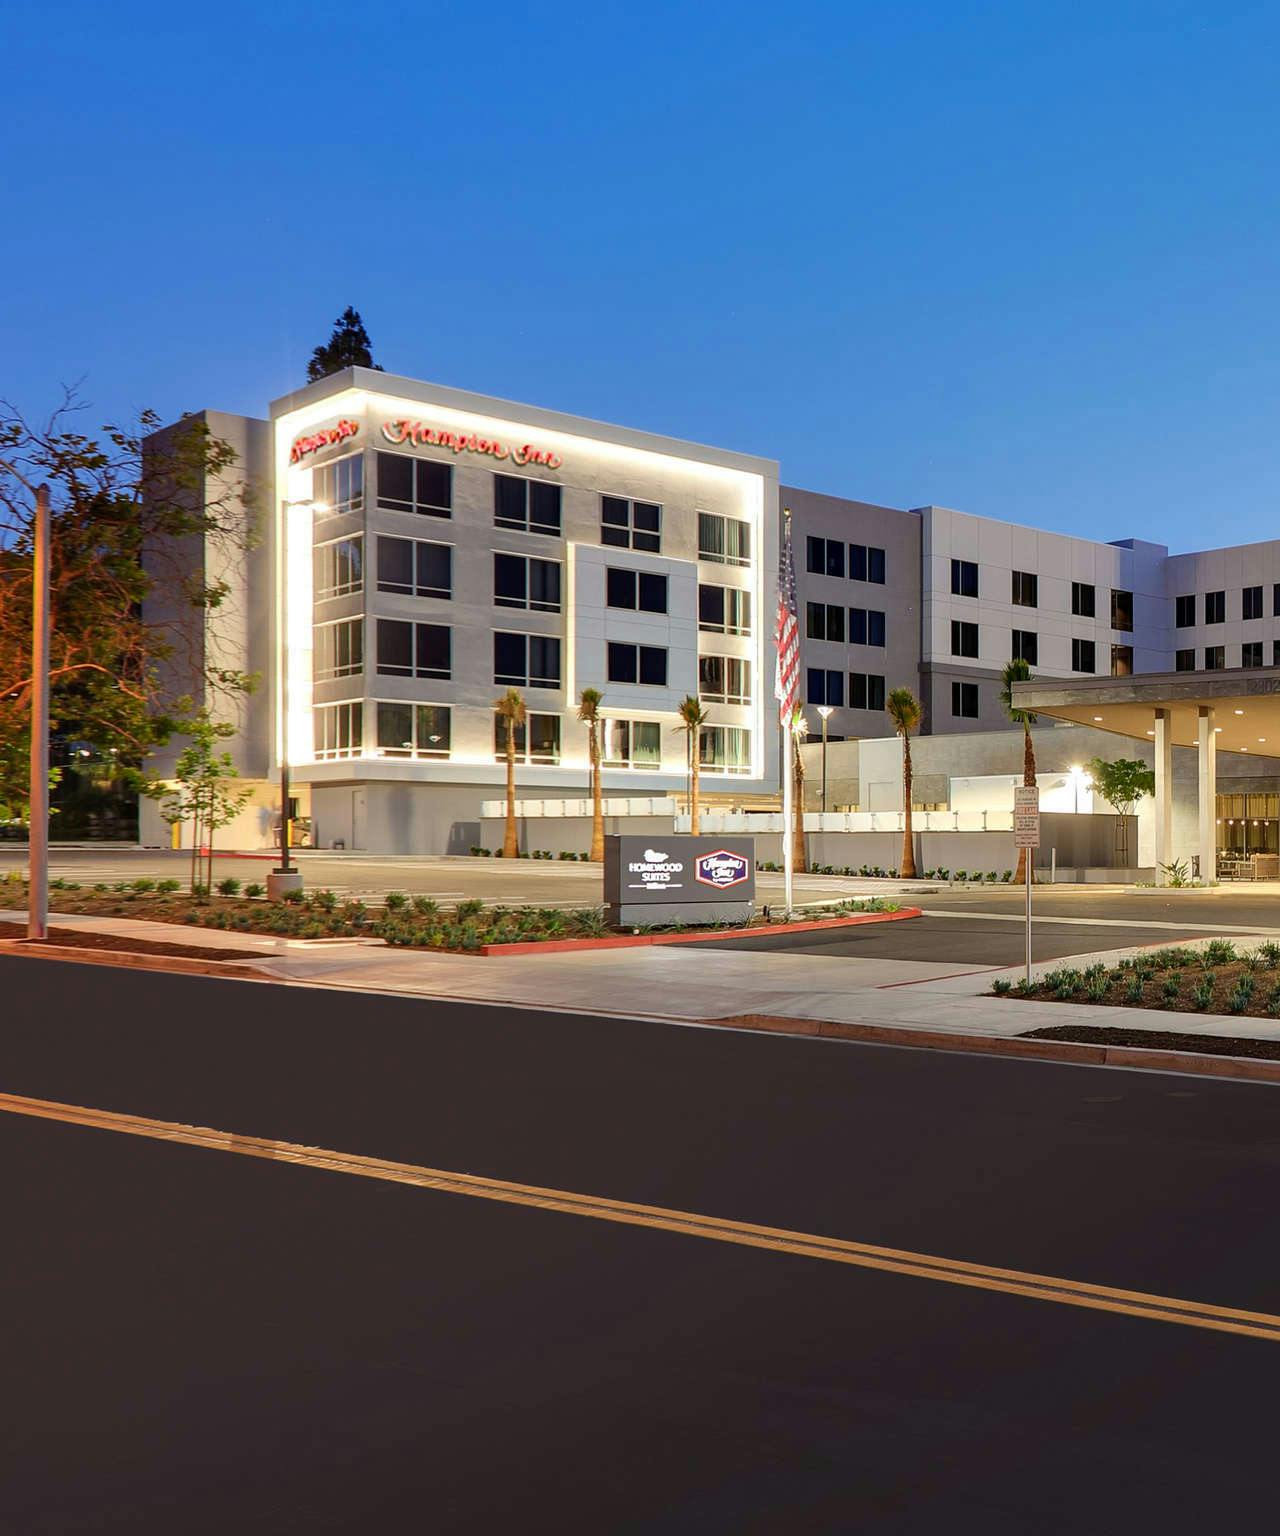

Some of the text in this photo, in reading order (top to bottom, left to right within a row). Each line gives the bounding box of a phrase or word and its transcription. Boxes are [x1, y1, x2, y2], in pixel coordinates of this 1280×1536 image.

[382, 418, 563, 469] Hampton Inn
[628, 862, 683, 872] HOMEWOOD
[641, 872, 671, 882] SUITES
